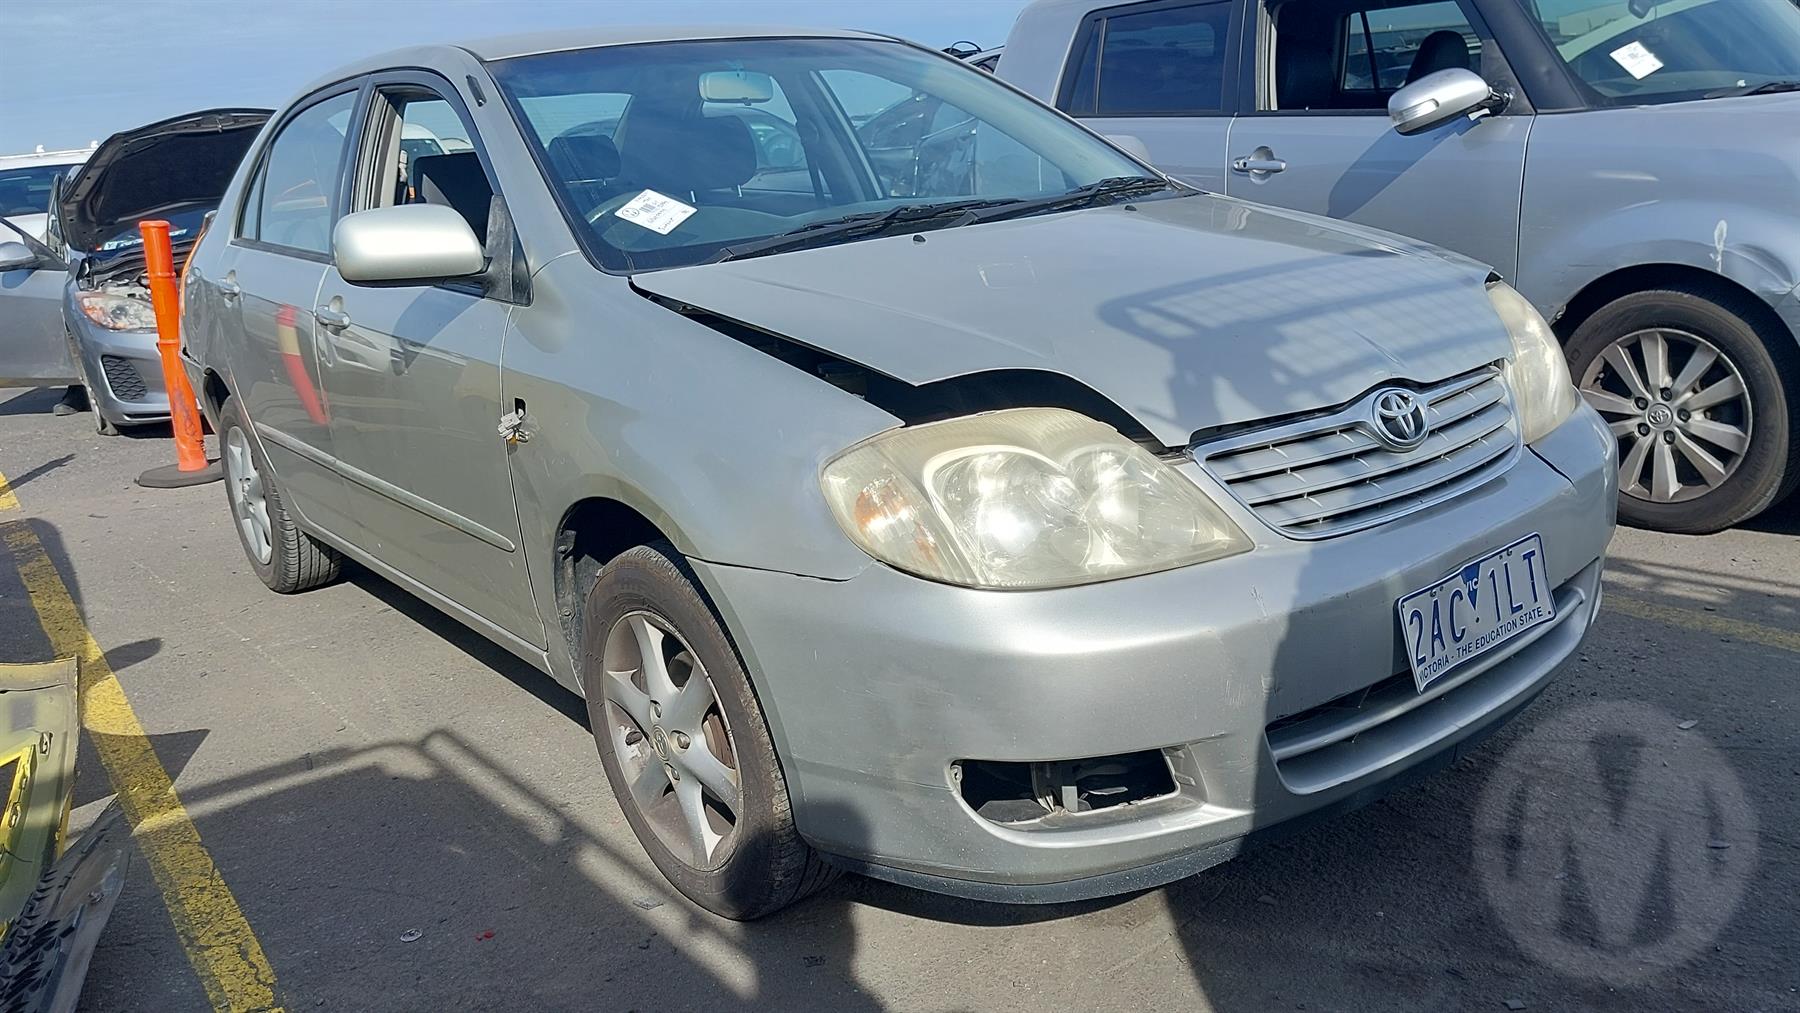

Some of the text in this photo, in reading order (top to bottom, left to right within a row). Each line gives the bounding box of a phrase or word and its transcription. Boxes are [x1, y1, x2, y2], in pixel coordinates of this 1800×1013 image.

[1456, 642, 1472, 658] THE
[1475, 619, 1517, 649] EDUCATION
[1519, 606, 1543, 627] STATE
